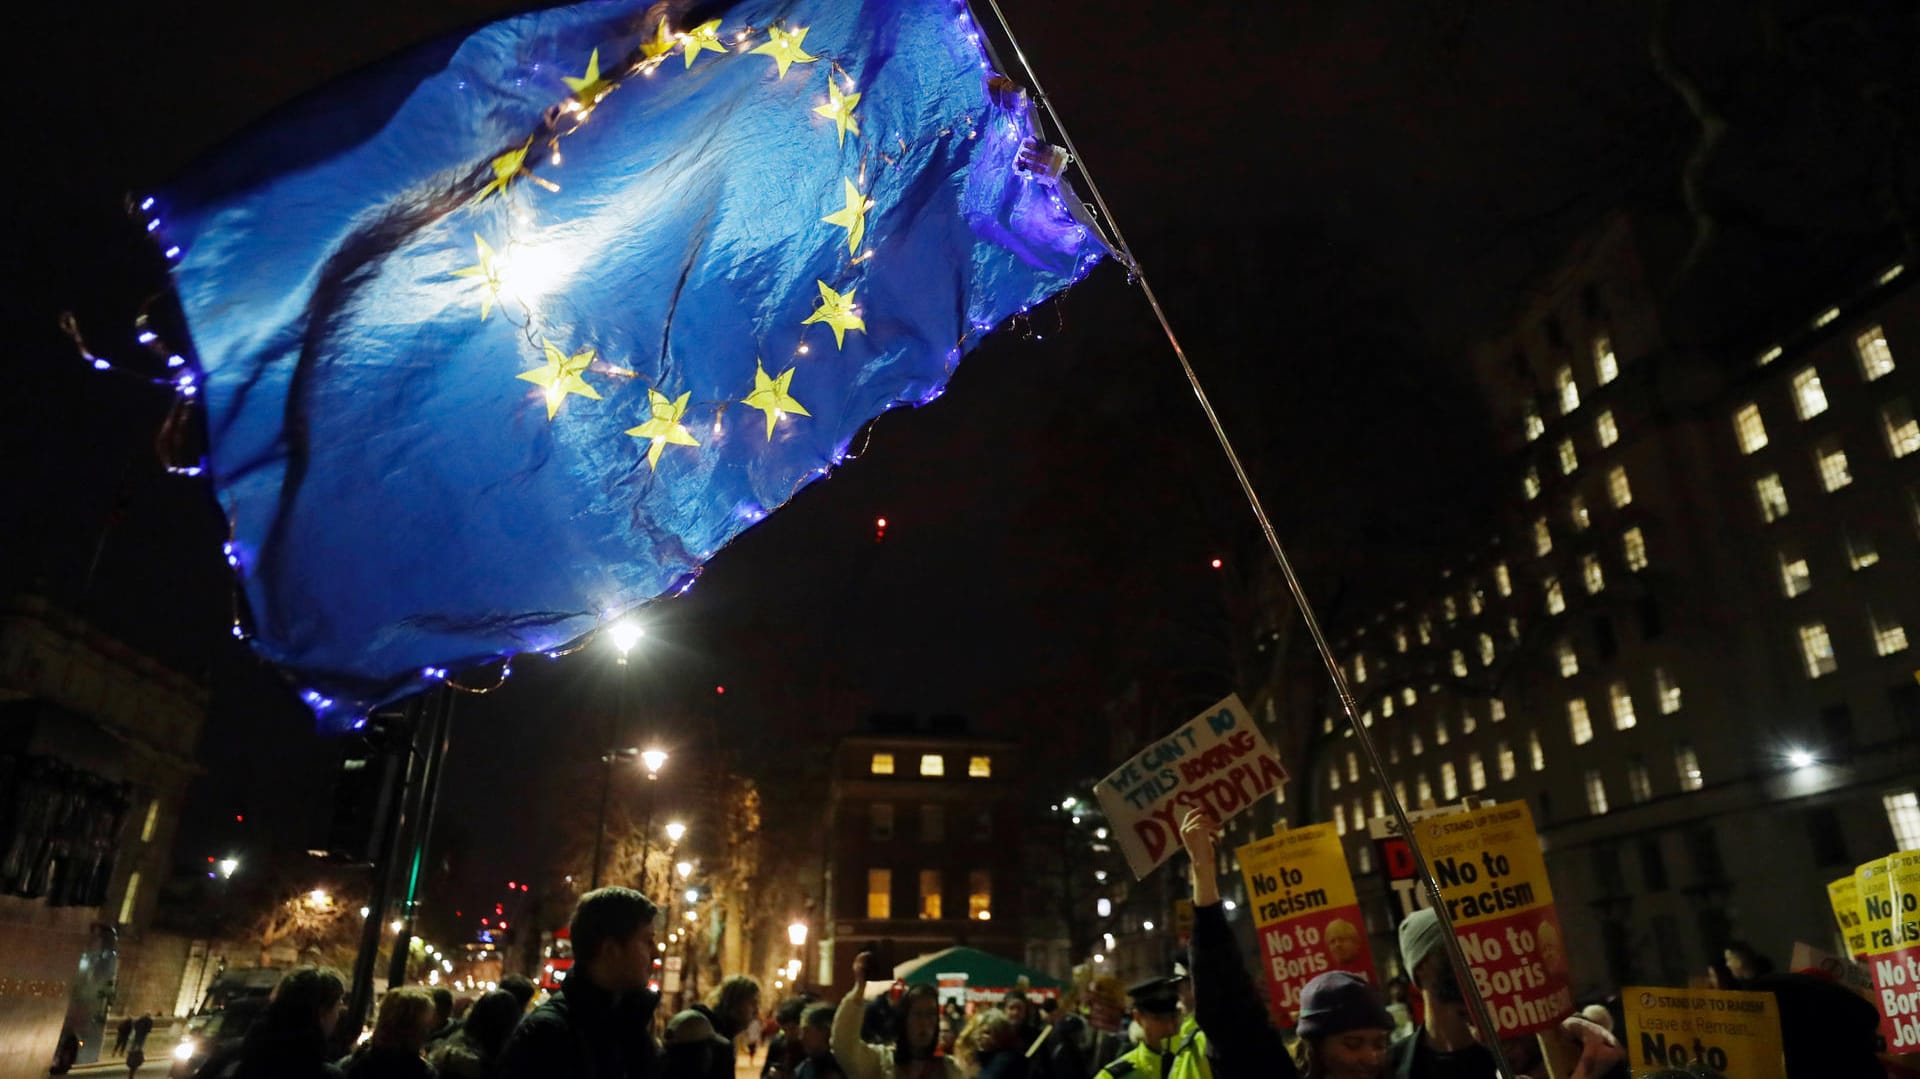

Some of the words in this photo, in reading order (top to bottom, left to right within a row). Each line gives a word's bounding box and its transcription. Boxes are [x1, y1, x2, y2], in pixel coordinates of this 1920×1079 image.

[1109, 761, 1142, 791] WE
[1207, 708, 1237, 738] DO
[1125, 768, 1180, 811] THIS
[1179, 730, 1256, 785] BORING
[1252, 872, 1278, 898] No
[1280, 866, 1303, 888] to
[1434, 857, 1478, 889] No
[1482, 851, 1510, 878] to
[1259, 888, 1328, 921] racism
[1446, 882, 1535, 922] racism
[1866, 895, 1893, 921] No
[1264, 930, 1294, 956] No
[1295, 925, 1320, 951] to
[1458, 931, 1502, 967] No
[1506, 926, 1536, 956] to
[1271, 949, 1329, 983] Boris
[1470, 958, 1546, 1000] Boris
[1876, 959, 1907, 988] No
[1658, 996, 1689, 1009] STAND
[1691, 999, 1706, 1010] UP
[1710, 1000, 1726, 1011] TO
[1639, 1016, 1681, 1032] Leave
[1641, 1031, 1689, 1068] No
[1692, 1037, 1729, 1072] to
